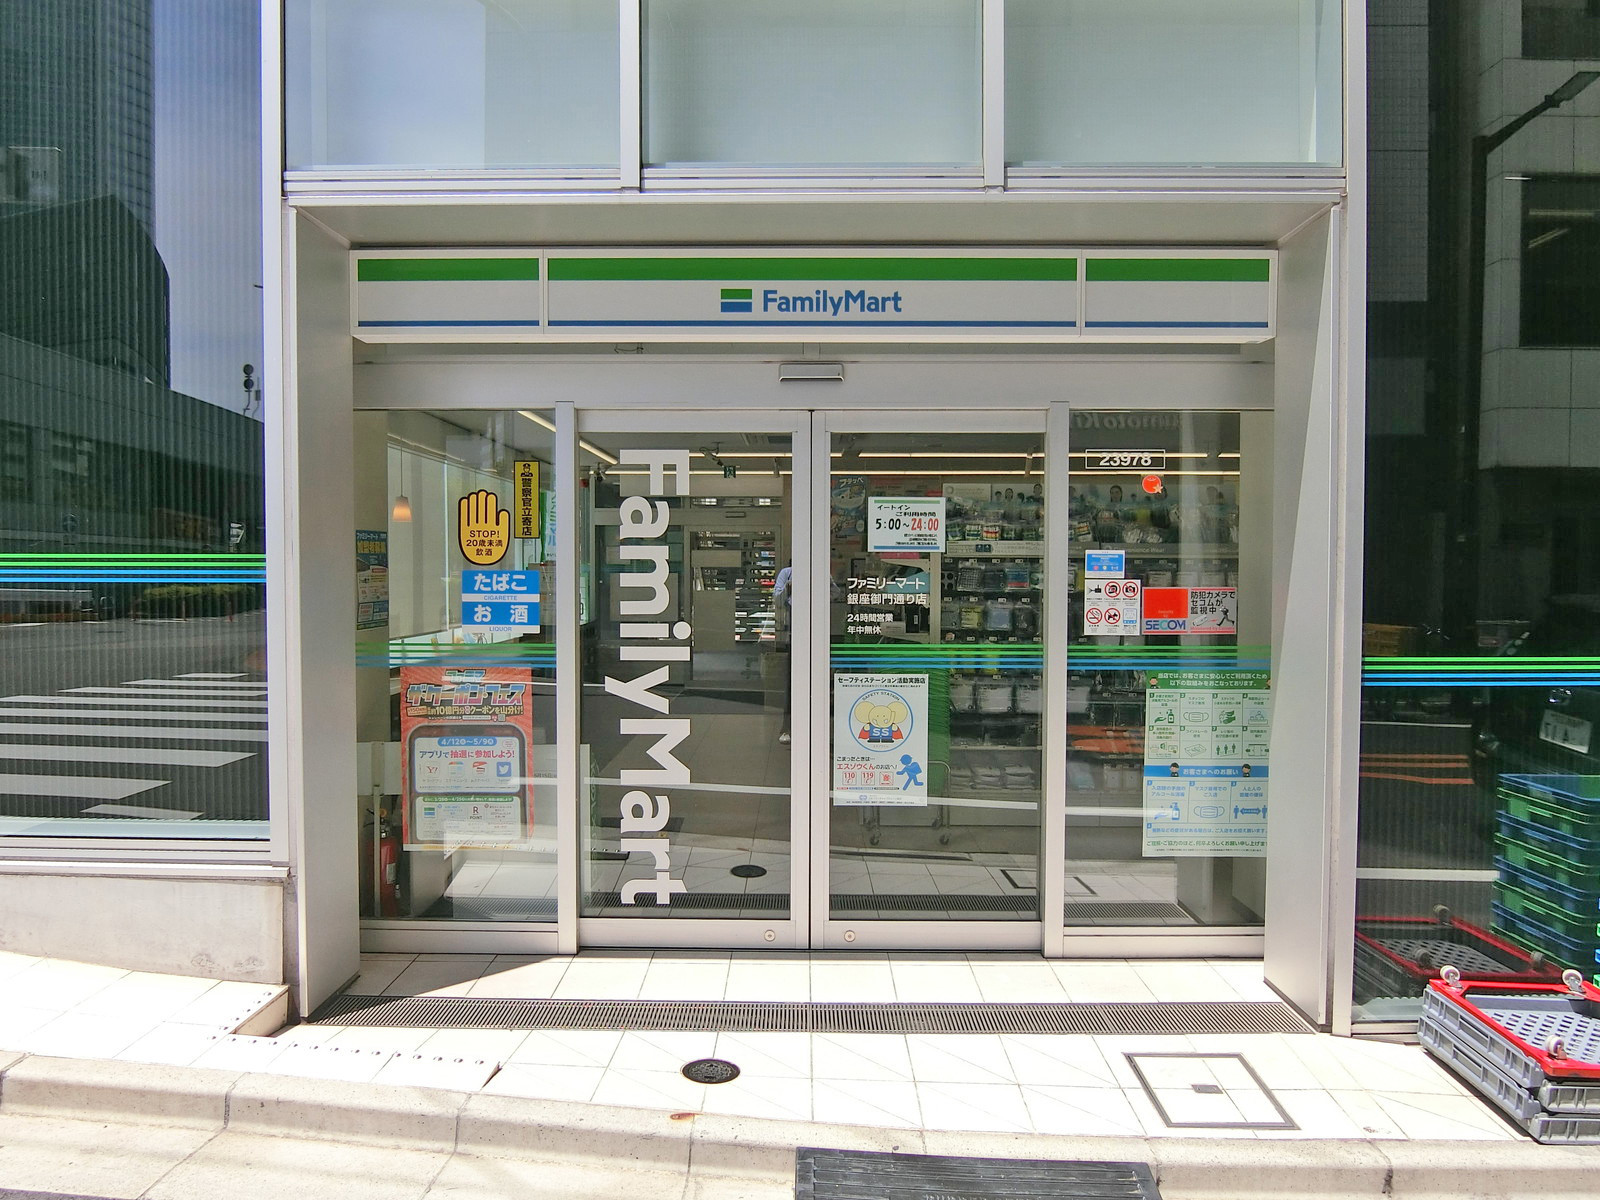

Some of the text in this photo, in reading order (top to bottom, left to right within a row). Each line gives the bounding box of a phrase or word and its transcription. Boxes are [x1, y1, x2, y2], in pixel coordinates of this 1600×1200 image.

[763, 289, 902, 316] FamilyMart
[1099, 452, 1152, 466] 23978
[521, 477, 532, 536] 警察官立寄店
[469, 530, 500, 538] STOP!
[466, 539, 503, 547] 20歳未満
[475, 548, 493, 557] 飲酒
[474, 573, 527, 591] たばこ
[847, 577, 925, 590] ファミリーマート
[847, 593, 927, 605] 銀座御門通り店
[1190, 591, 1235, 600] 防犯カメラで
[474, 605, 529, 623] お 酒
[1190, 606, 1217, 615] 監視中
[847, 613, 894, 623] 24時間営業
[847, 625, 882, 635] 年中無休
[1145, 620, 1186, 630] SECOM
[605, 449, 691, 904] FamilyMart
[419, 750, 515, 759] アプリで抽選に参加しよう!
